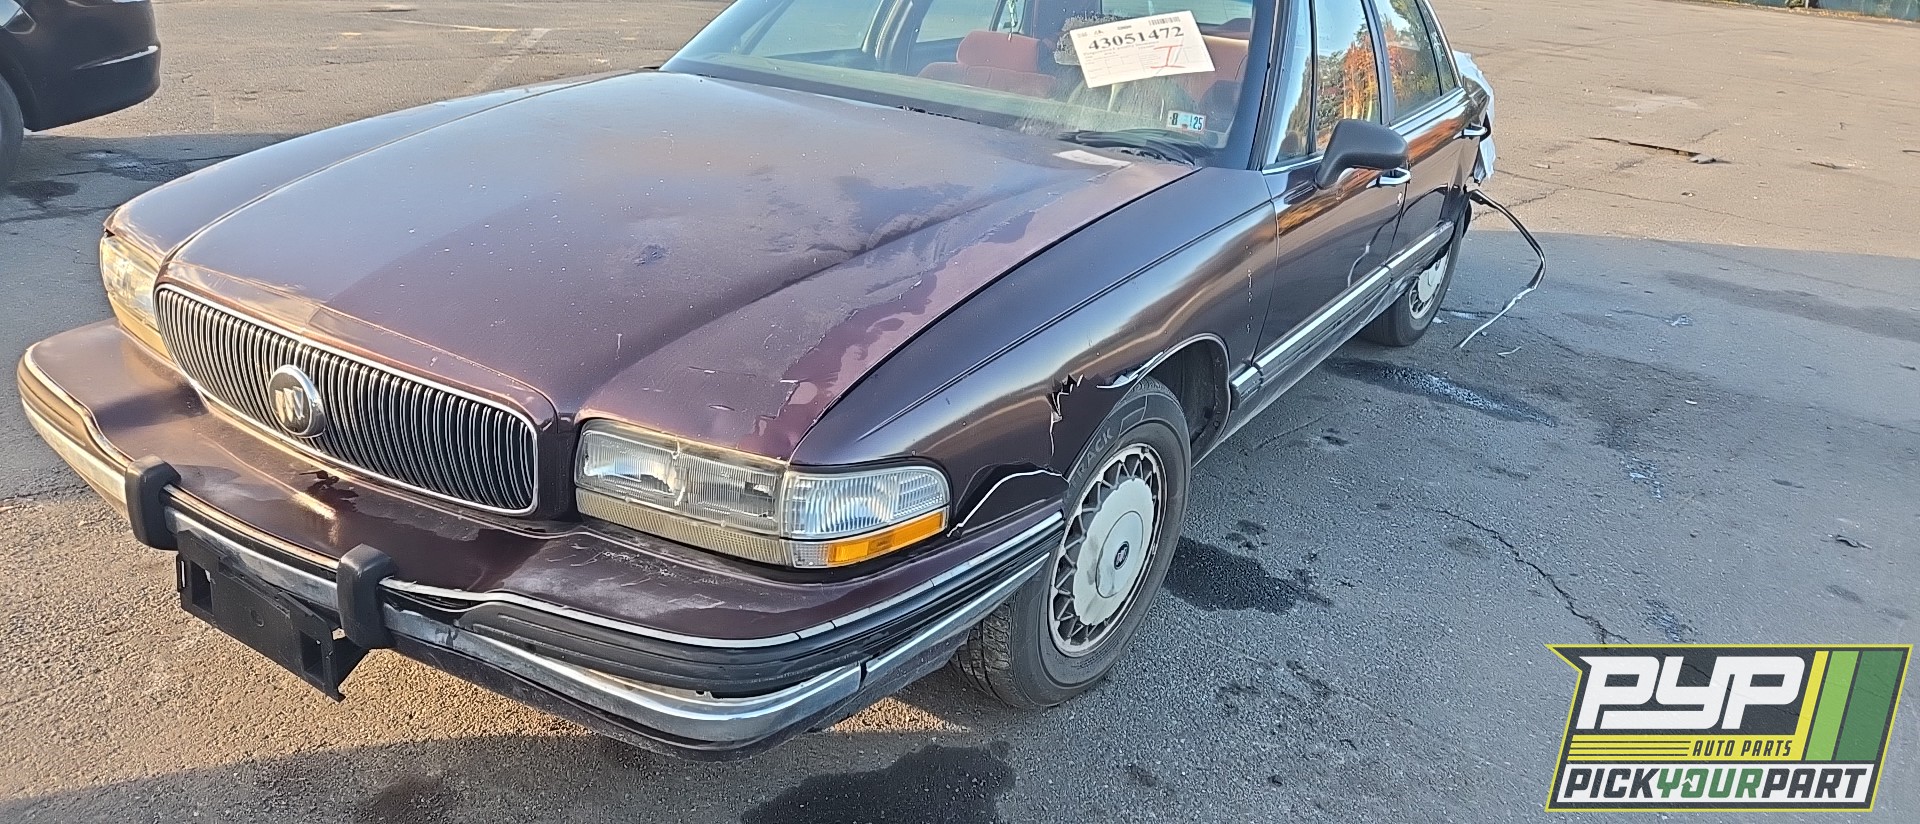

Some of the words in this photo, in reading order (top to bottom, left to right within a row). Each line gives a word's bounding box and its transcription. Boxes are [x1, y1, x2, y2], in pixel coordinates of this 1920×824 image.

[1088, 26, 1184, 50] 43051472
[1171, 112, 1179, 126] 8
[1192, 115, 1204, 131] 25
